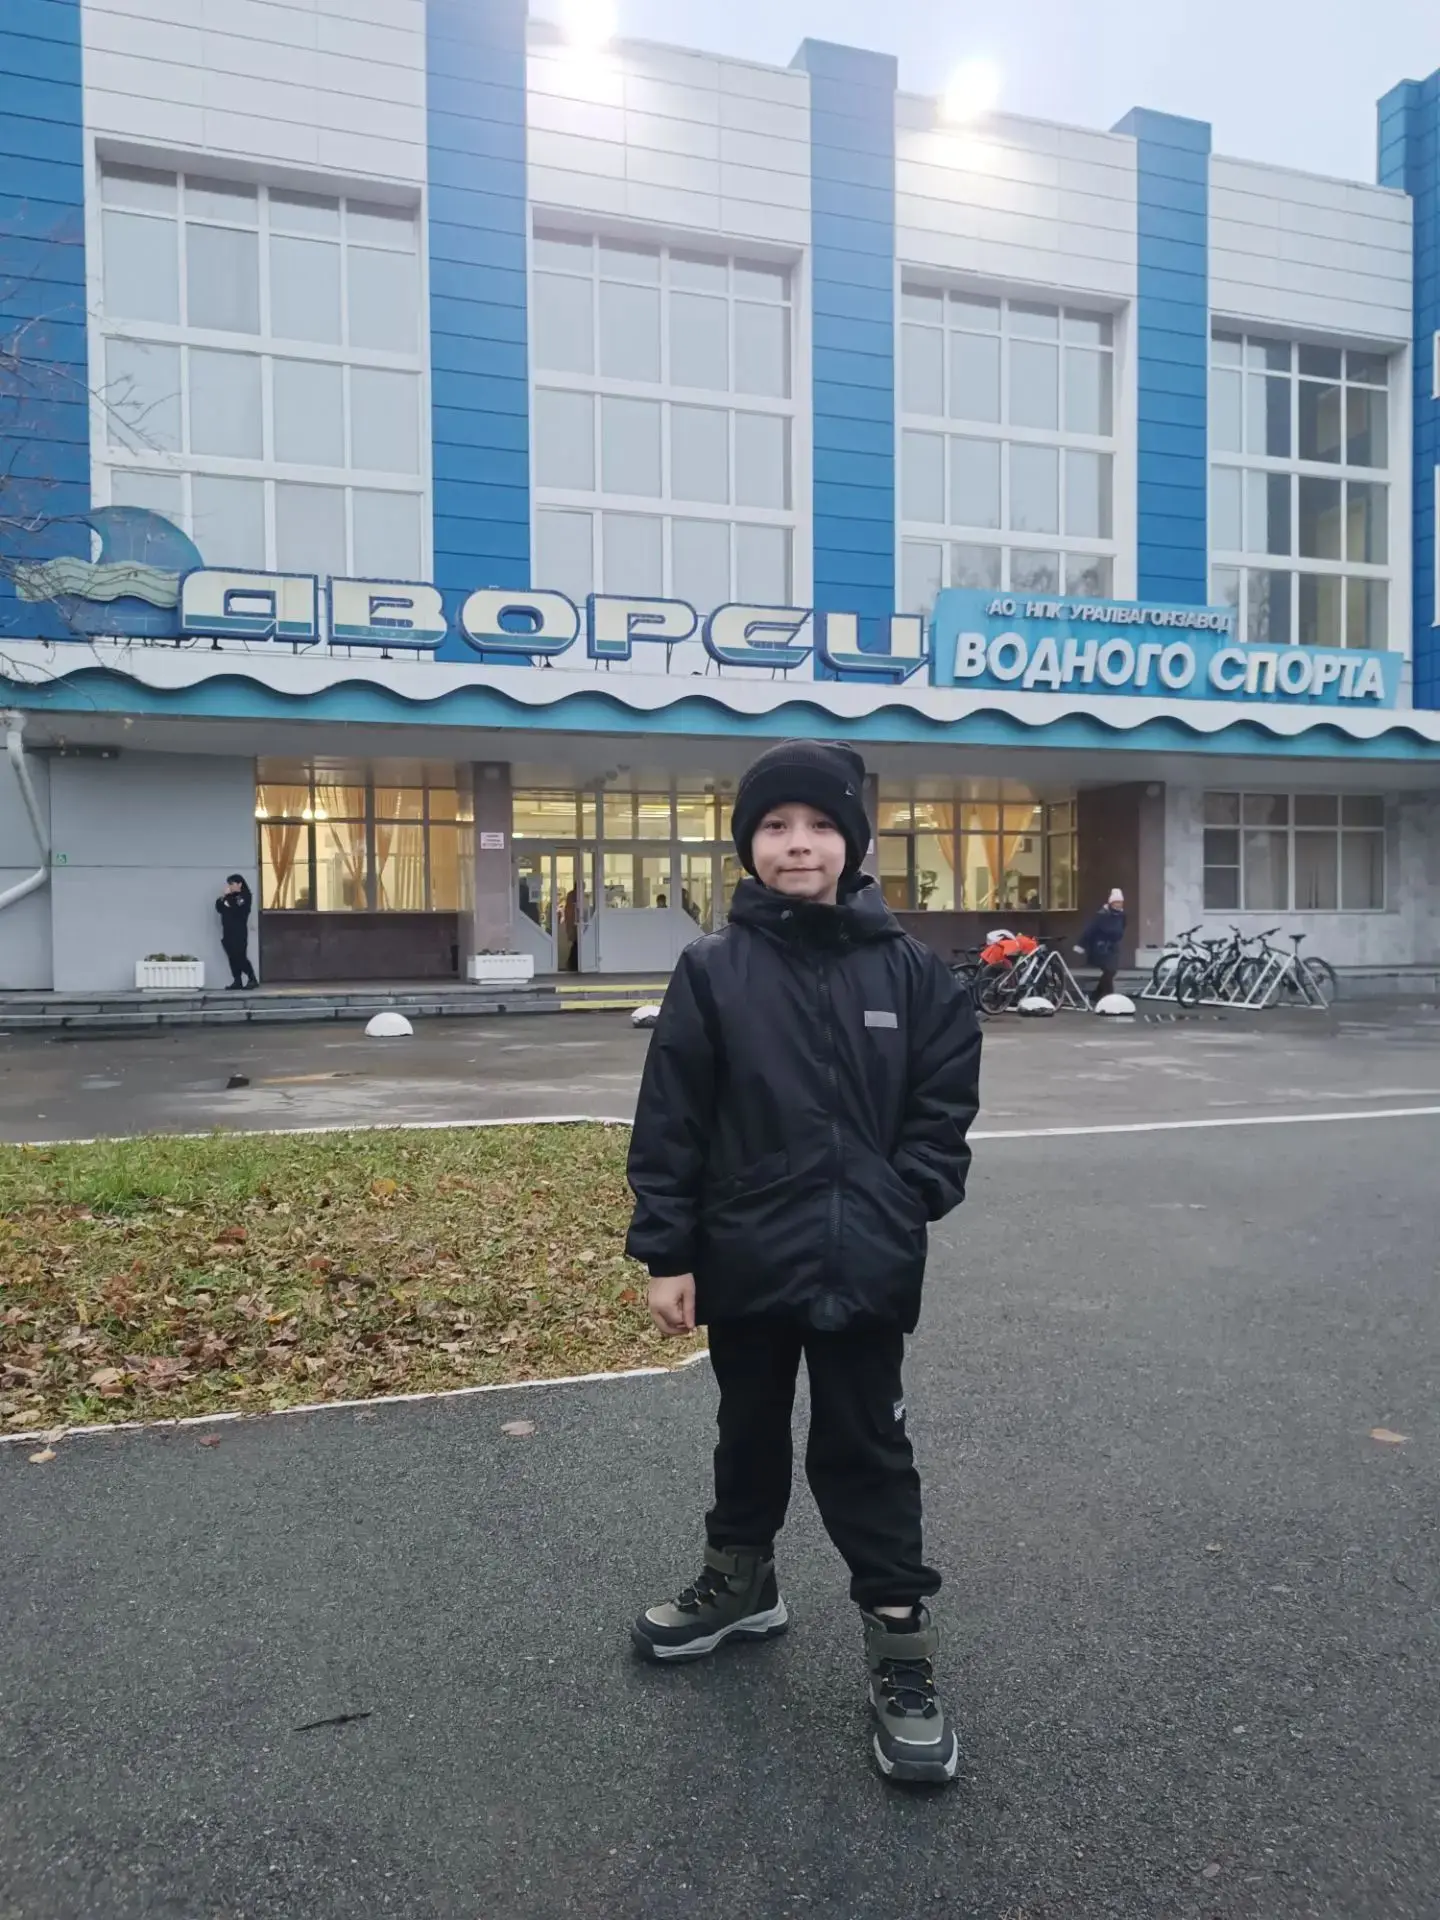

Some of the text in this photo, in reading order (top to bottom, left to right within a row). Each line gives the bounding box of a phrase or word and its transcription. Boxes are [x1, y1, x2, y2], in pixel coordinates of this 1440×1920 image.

[178, 566, 930, 685] ДВОРЕЦ
[987, 599, 1233, 634] АО НПК УРАЛВАГОНЗАВОД
[953, 631, 1386, 700] ВОДНОГО СПОРТА
